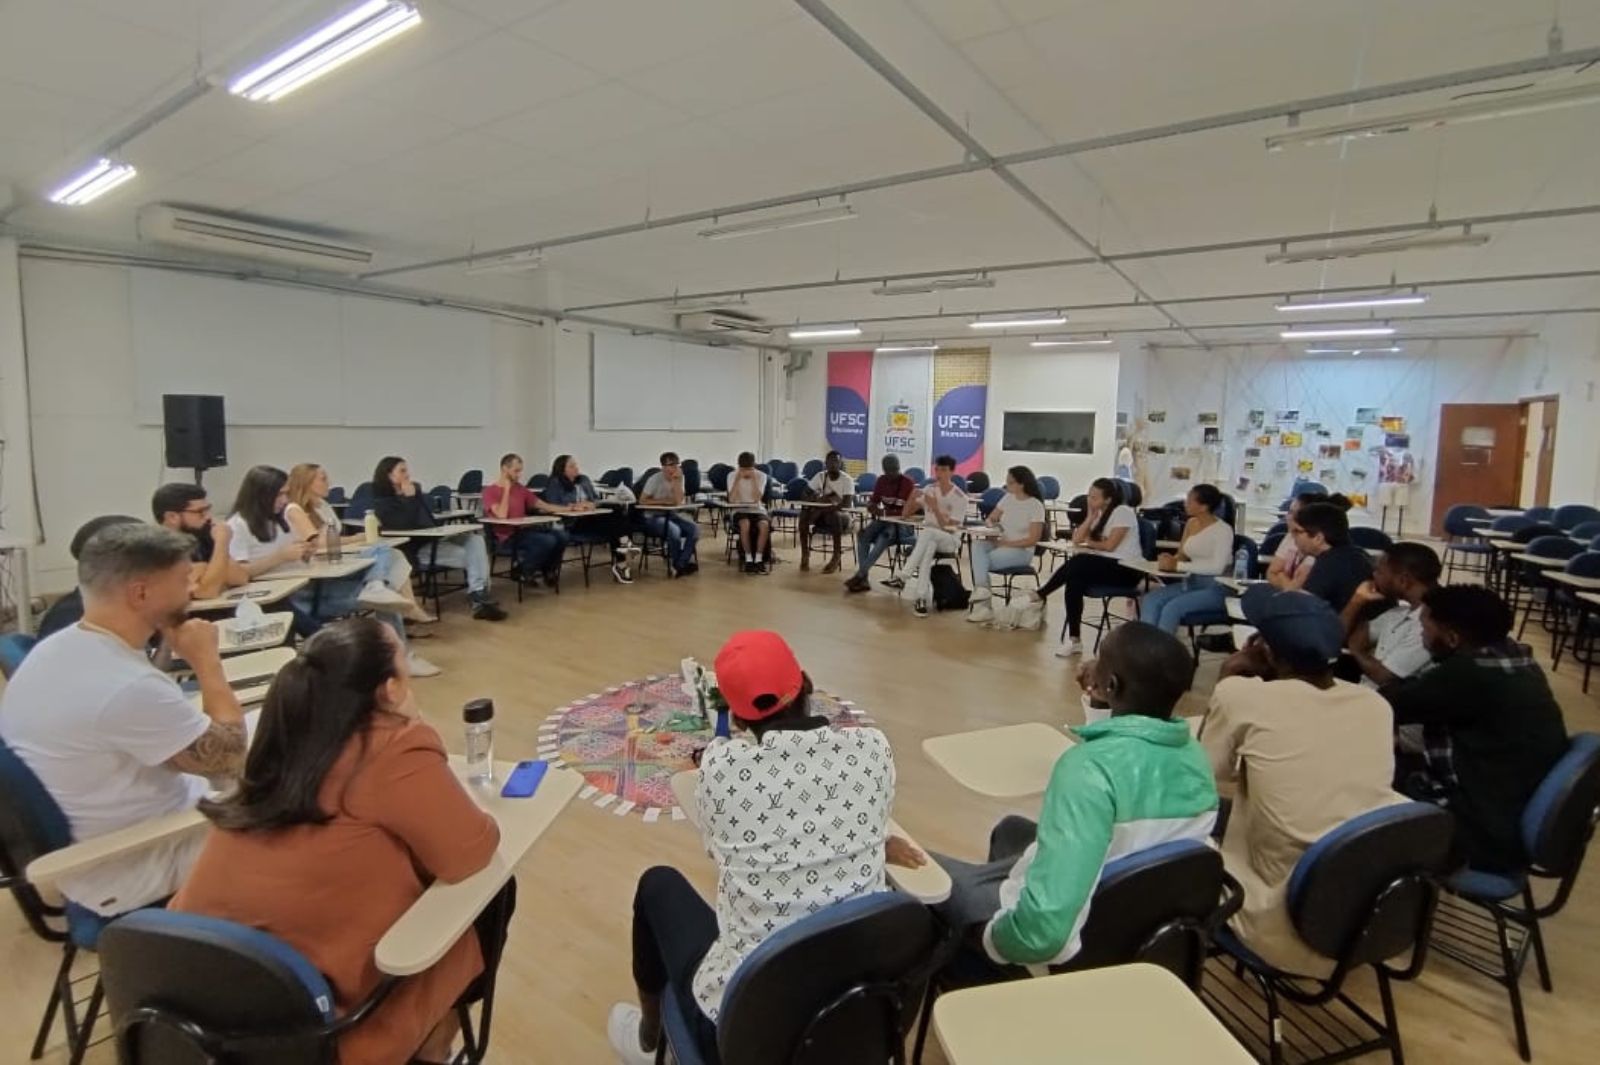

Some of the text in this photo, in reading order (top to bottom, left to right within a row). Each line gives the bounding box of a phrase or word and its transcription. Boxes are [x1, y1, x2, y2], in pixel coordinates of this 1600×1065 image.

[830, 412, 866, 426] UFSC
[938, 415, 981, 430] UFSC
[885, 436, 915, 448] UFSC
